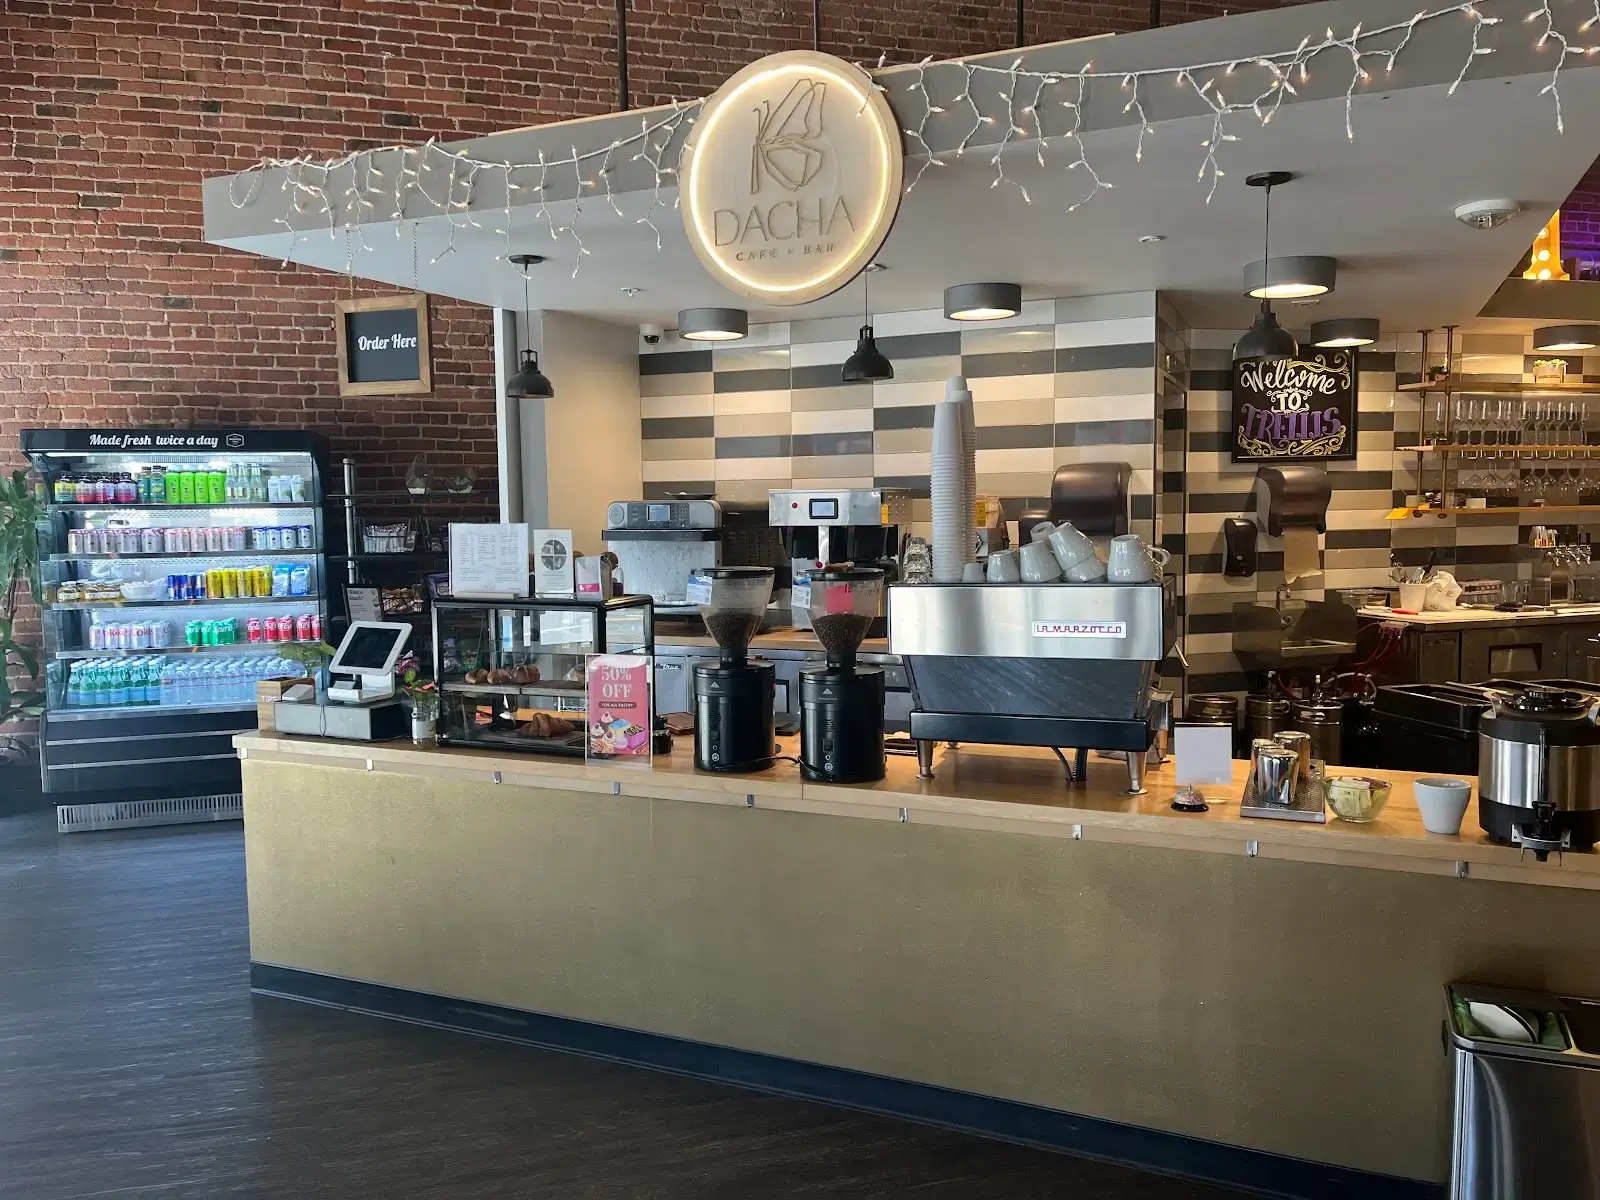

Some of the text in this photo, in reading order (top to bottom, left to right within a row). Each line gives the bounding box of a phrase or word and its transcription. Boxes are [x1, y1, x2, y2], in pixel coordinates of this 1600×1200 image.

[713, 195, 856, 247] DACHA
[803, 243, 834, 255] BAR
[357, 333, 417, 351] Order Here
[1240, 359, 1337, 395] Welcome
[1276, 392, 1302, 411] TO
[1240, 403, 1342, 447] TRELLIS
[89, 434, 121, 446] Made
[120, 434, 152, 448] fresh
[155, 434, 184, 446] twice
[186, 437, 195, 446] a
[196, 435, 219, 448] day
[601, 666, 632, 681] 50%
[602, 683, 632, 698] OFF
